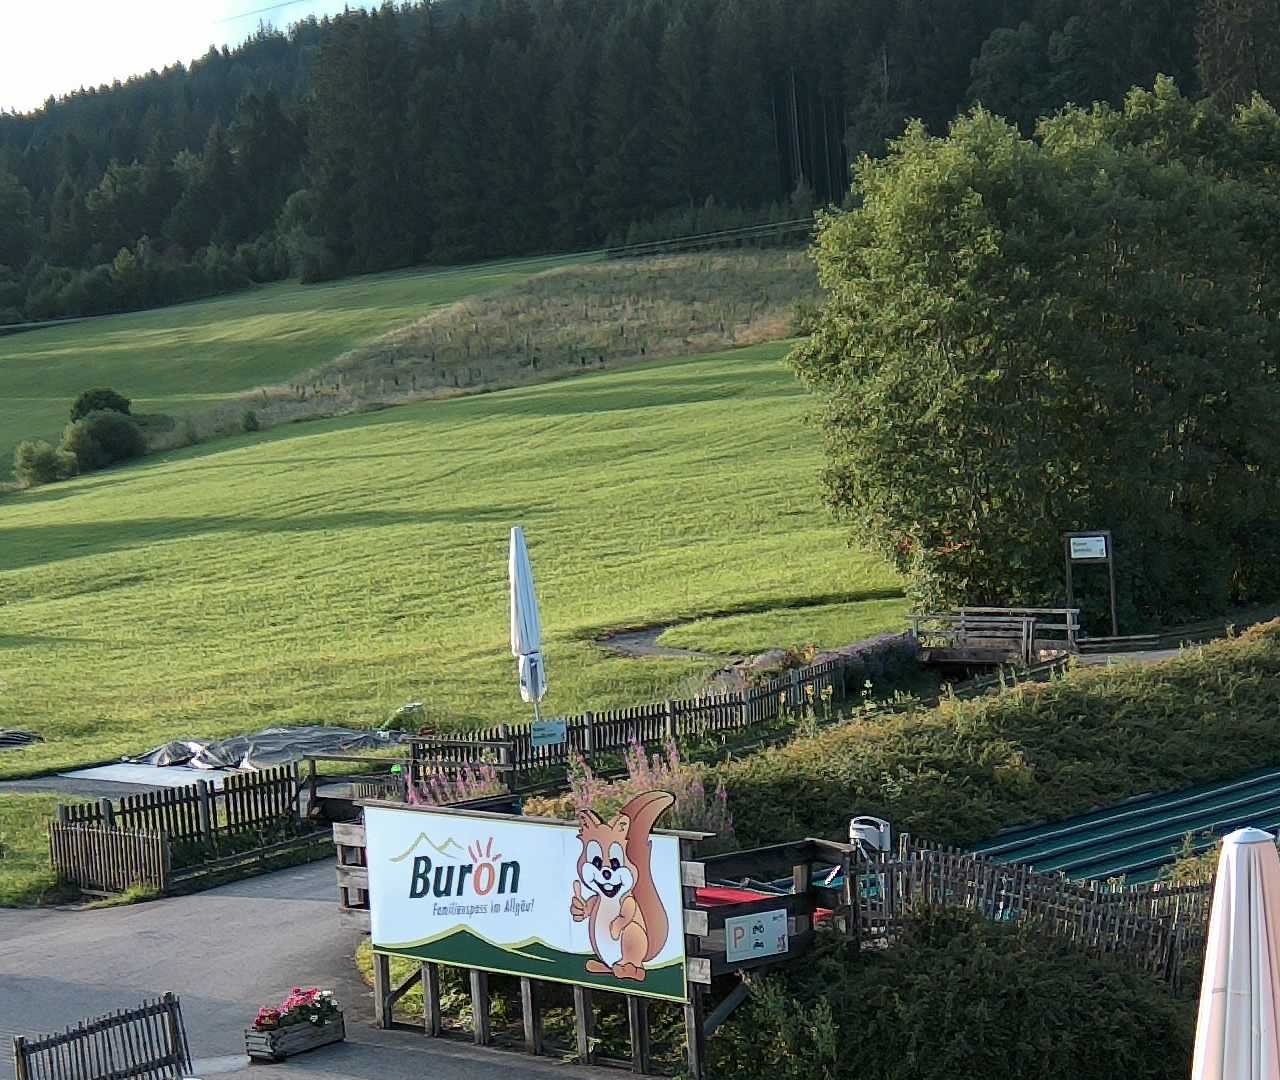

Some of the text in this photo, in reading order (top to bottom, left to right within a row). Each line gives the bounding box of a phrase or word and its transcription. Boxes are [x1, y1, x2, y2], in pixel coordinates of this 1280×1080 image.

[409, 855, 521, 898] Buron
[490, 900, 501, 913] im
[733, 926, 745, 949] P
